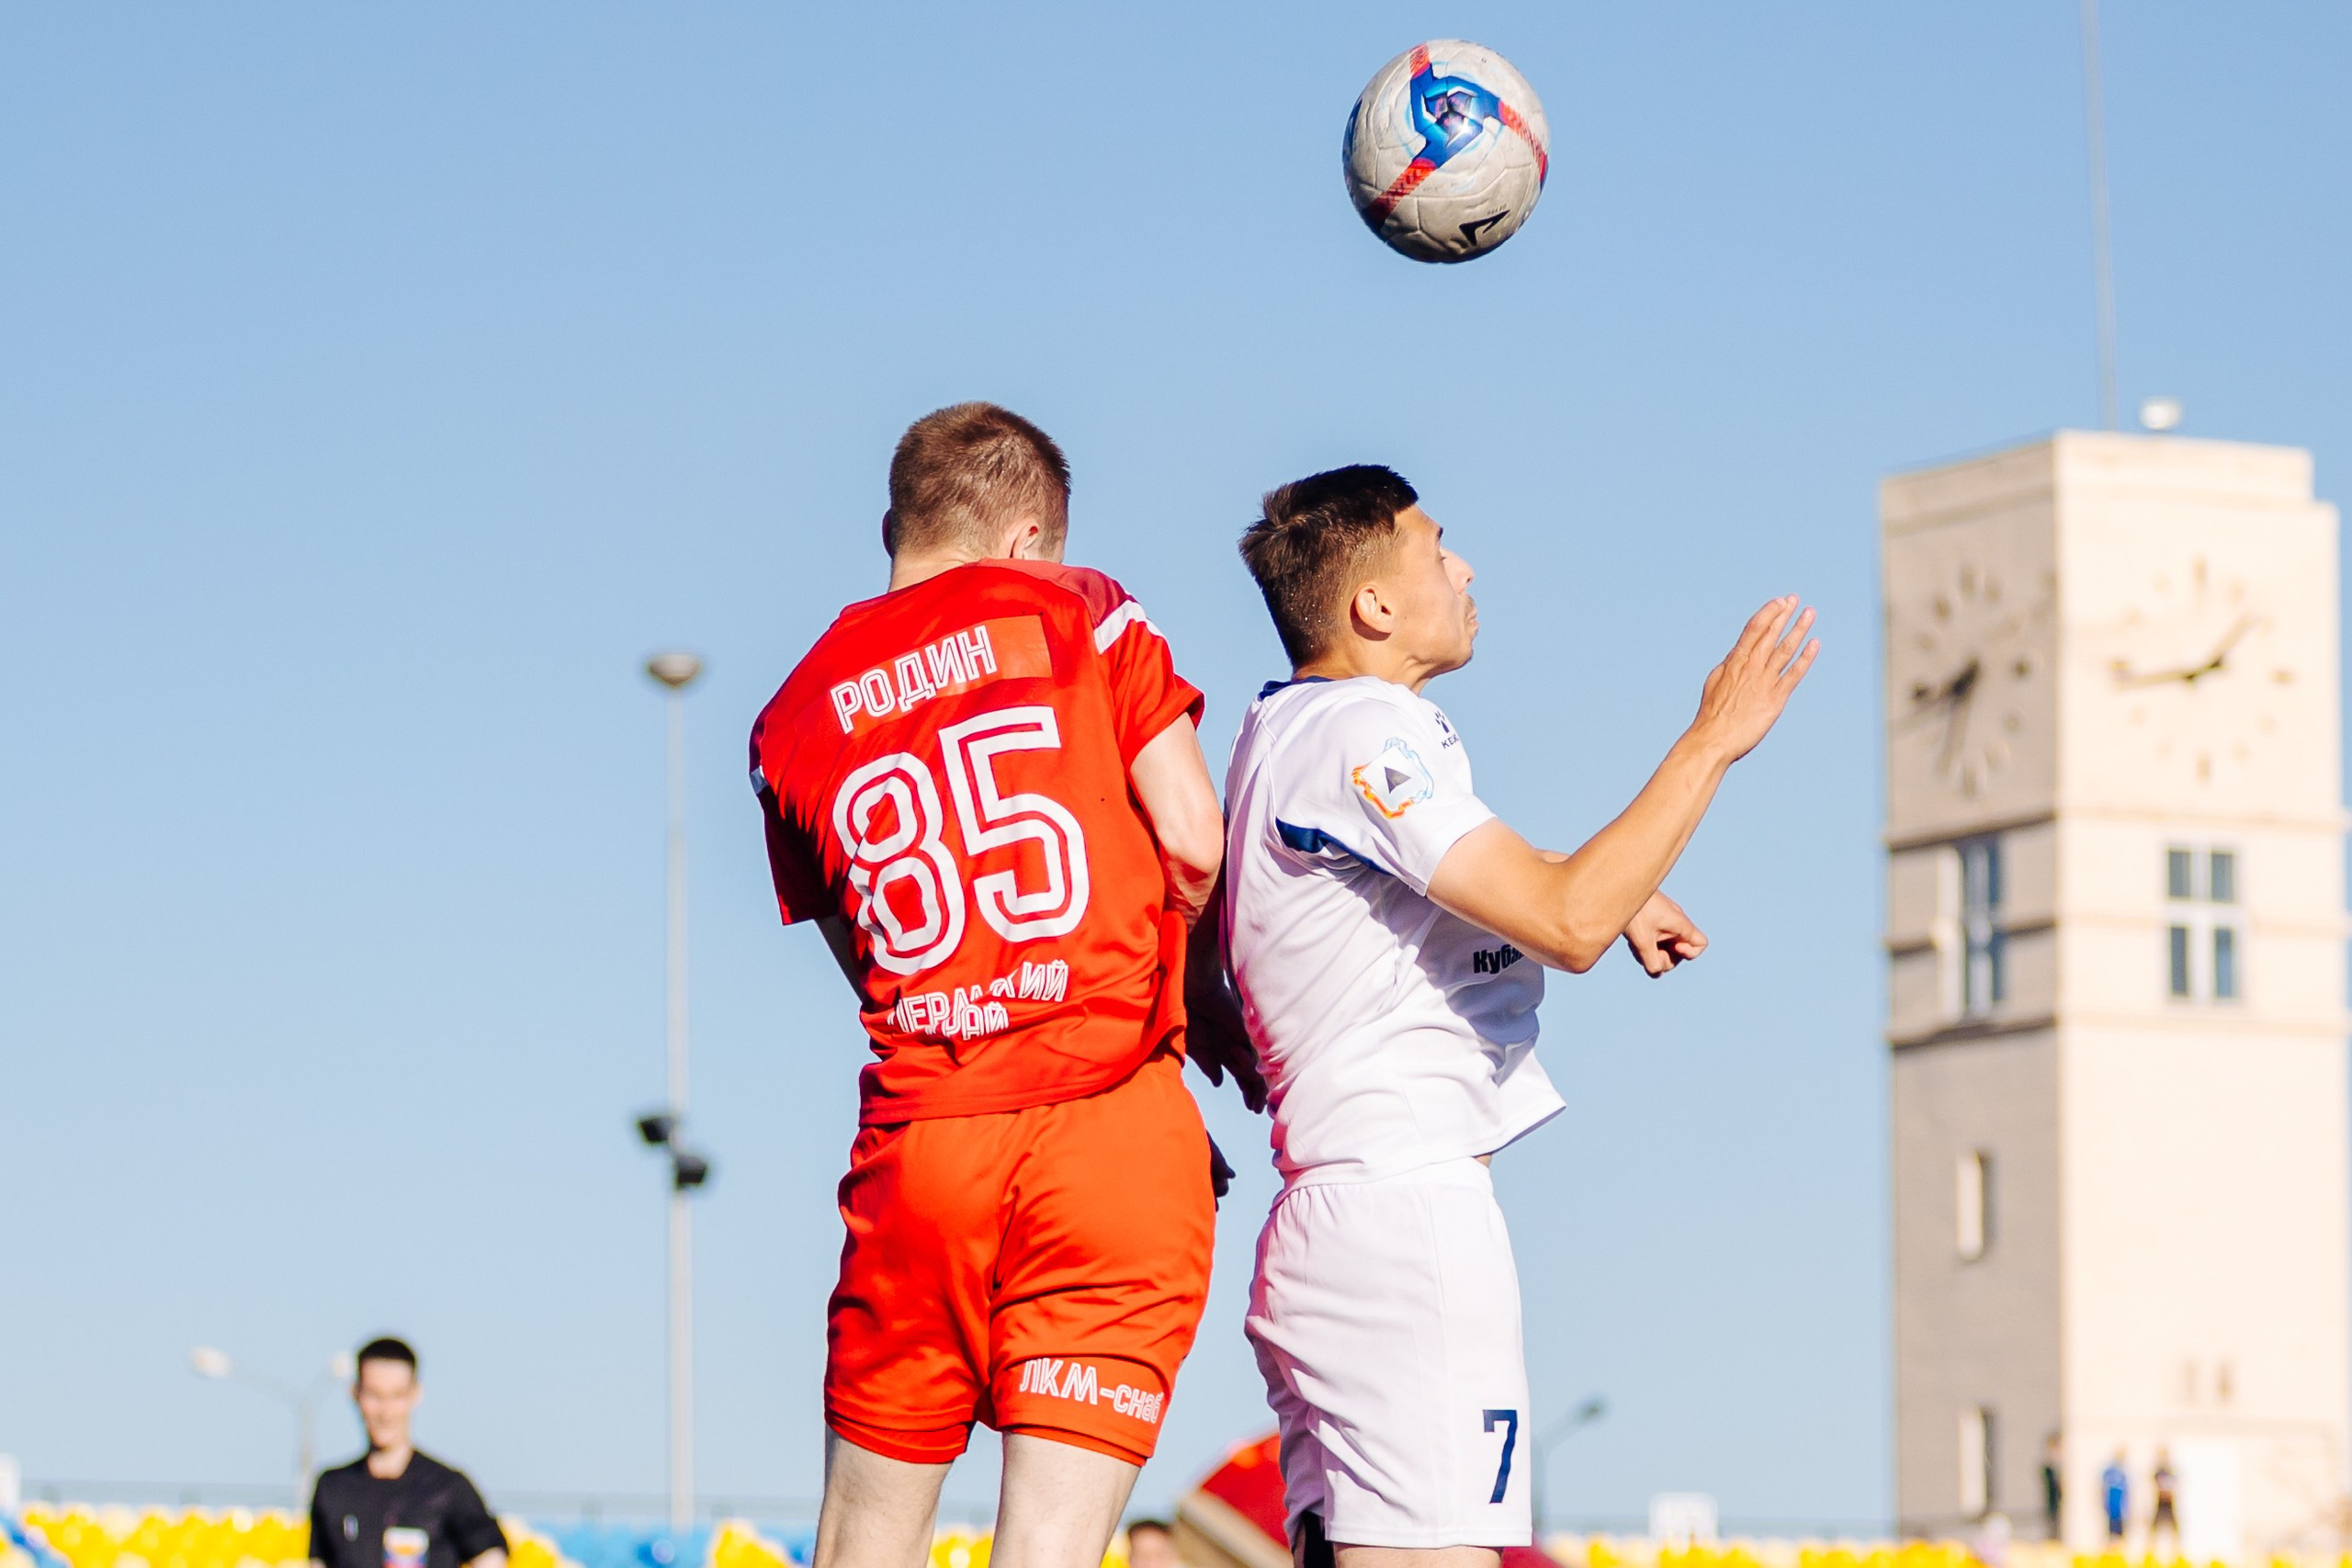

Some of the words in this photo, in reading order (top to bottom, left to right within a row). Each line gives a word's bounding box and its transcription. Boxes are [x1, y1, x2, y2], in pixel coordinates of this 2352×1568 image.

[830, 625, 997, 734] РОДИН
[832, 705, 1091, 976] 85
[1473, 943, 1524, 975] Куба
[1482, 1409, 1518, 1504] 7
